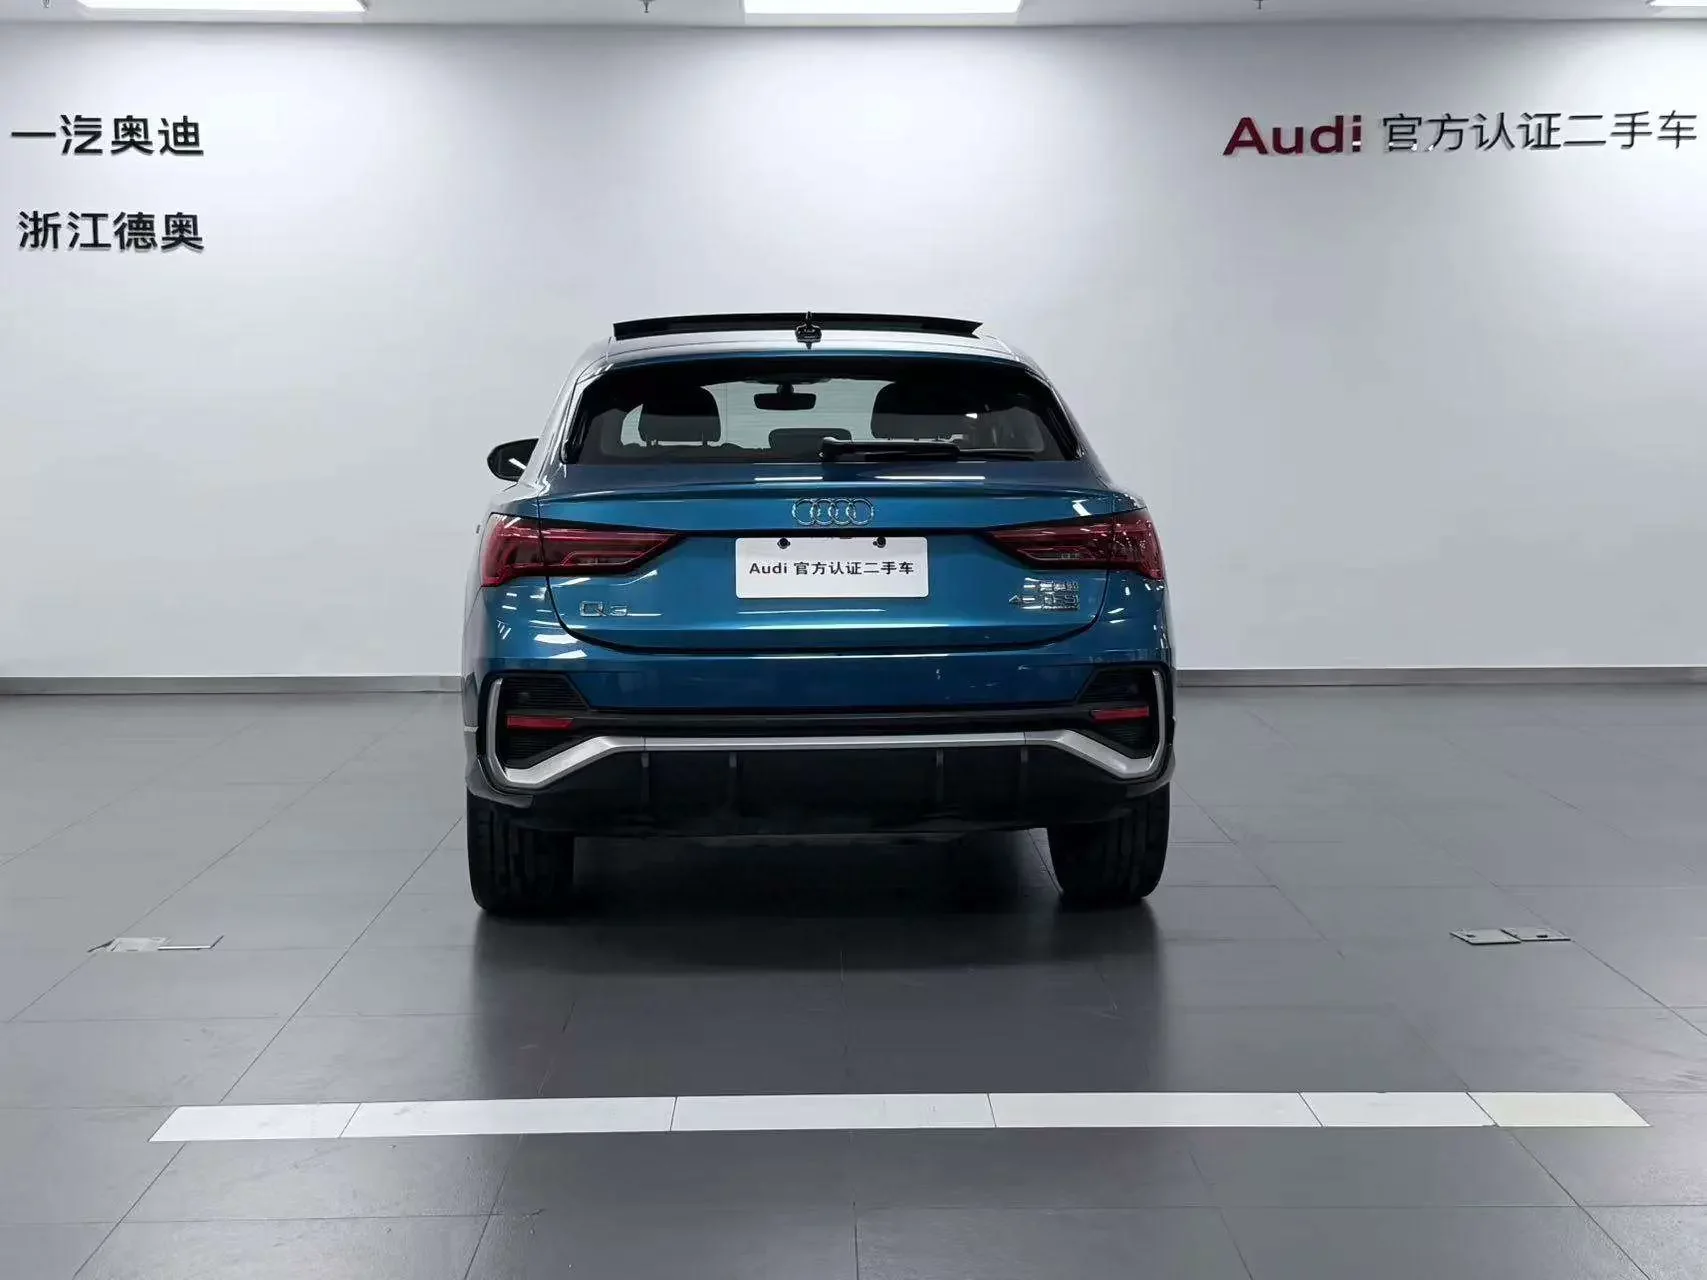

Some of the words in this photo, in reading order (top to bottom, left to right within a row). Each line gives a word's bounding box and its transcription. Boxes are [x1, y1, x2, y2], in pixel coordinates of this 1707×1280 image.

[11, 114, 204, 156] 一汽奥迪
[1223, 115, 1361, 155] Audi
[1383, 110, 1697, 151] 官方认证二手车
[18, 210, 204, 252] 浙江德奥
[749, 562, 787, 575] Audi
[794, 561, 914, 575] 官方认证二手车
